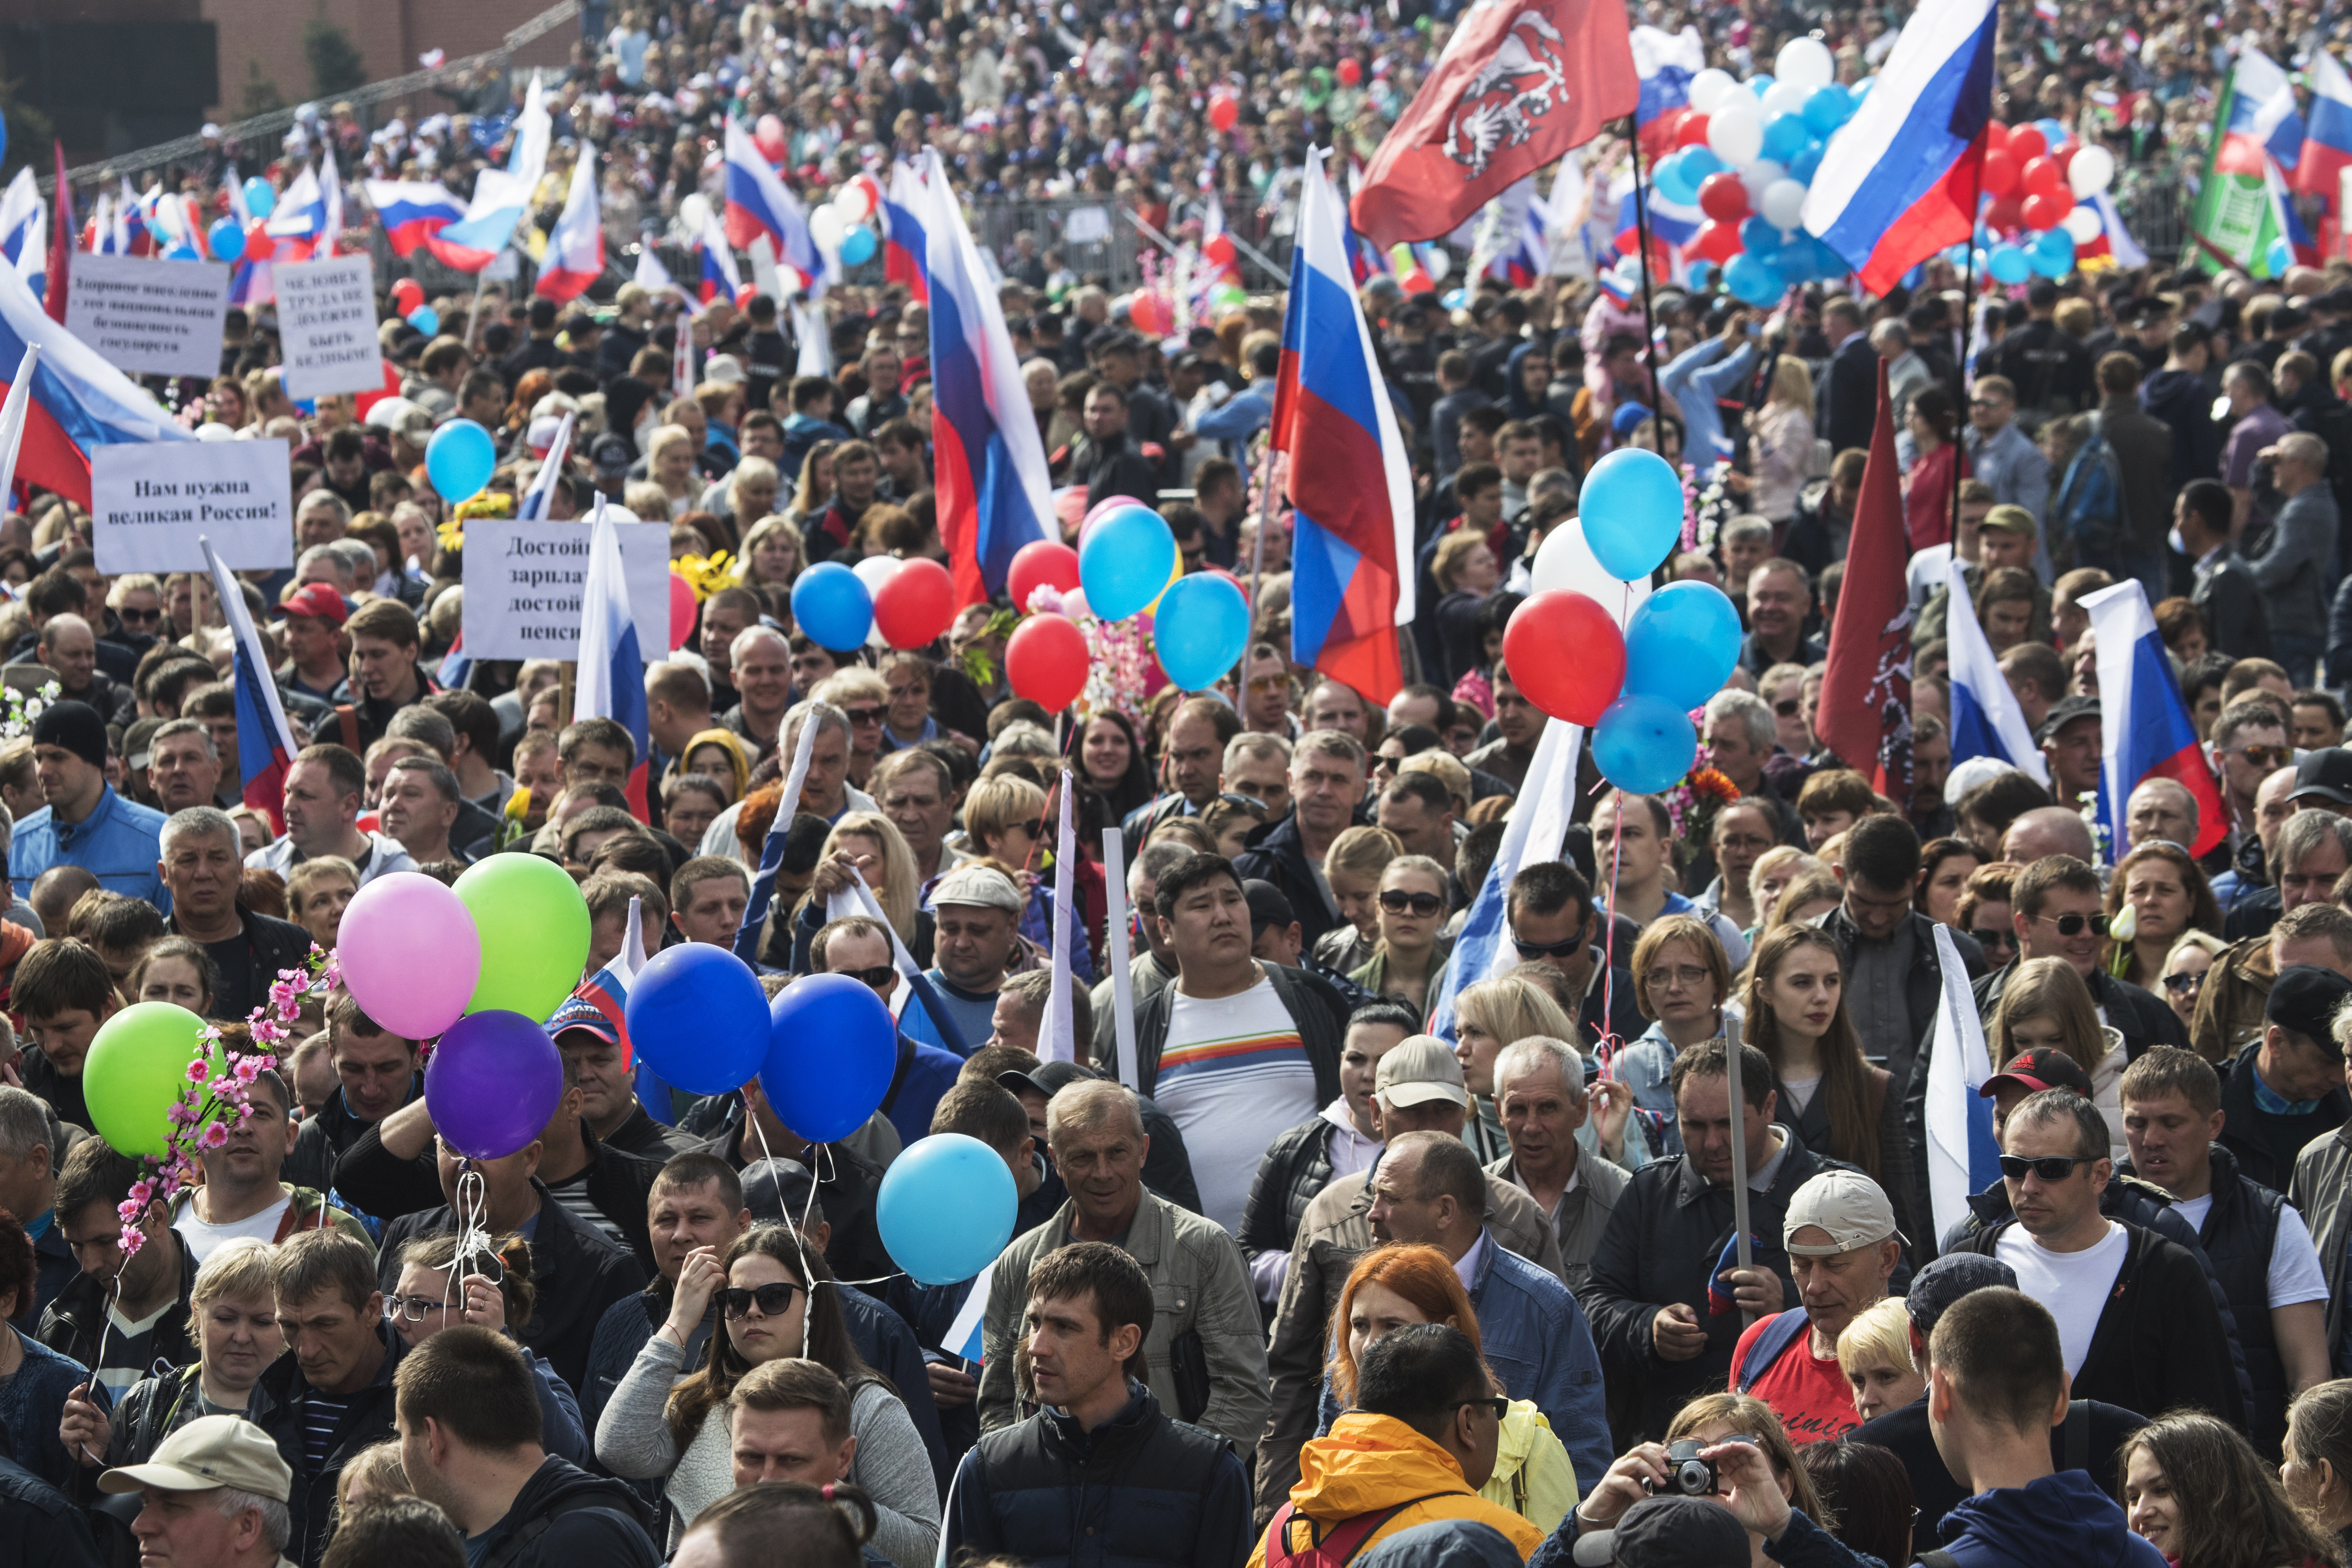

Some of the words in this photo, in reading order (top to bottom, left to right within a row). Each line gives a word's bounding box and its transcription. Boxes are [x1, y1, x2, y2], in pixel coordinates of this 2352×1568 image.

[285, 270, 359, 290] ЧЕЛОВЕК
[342, 289, 362, 303] НЕ
[308, 332, 354, 348] БЫТЬ
[135, 480, 177, 498] Нам
[185, 480, 250, 500] нужна
[108, 508, 193, 525] великая
[200, 502, 276, 522] Россия!
[506, 536, 623, 557] Достой
[509, 570, 588, 588] зарпла
[508, 595, 583, 613] достой
[521, 626, 580, 640] пенси
